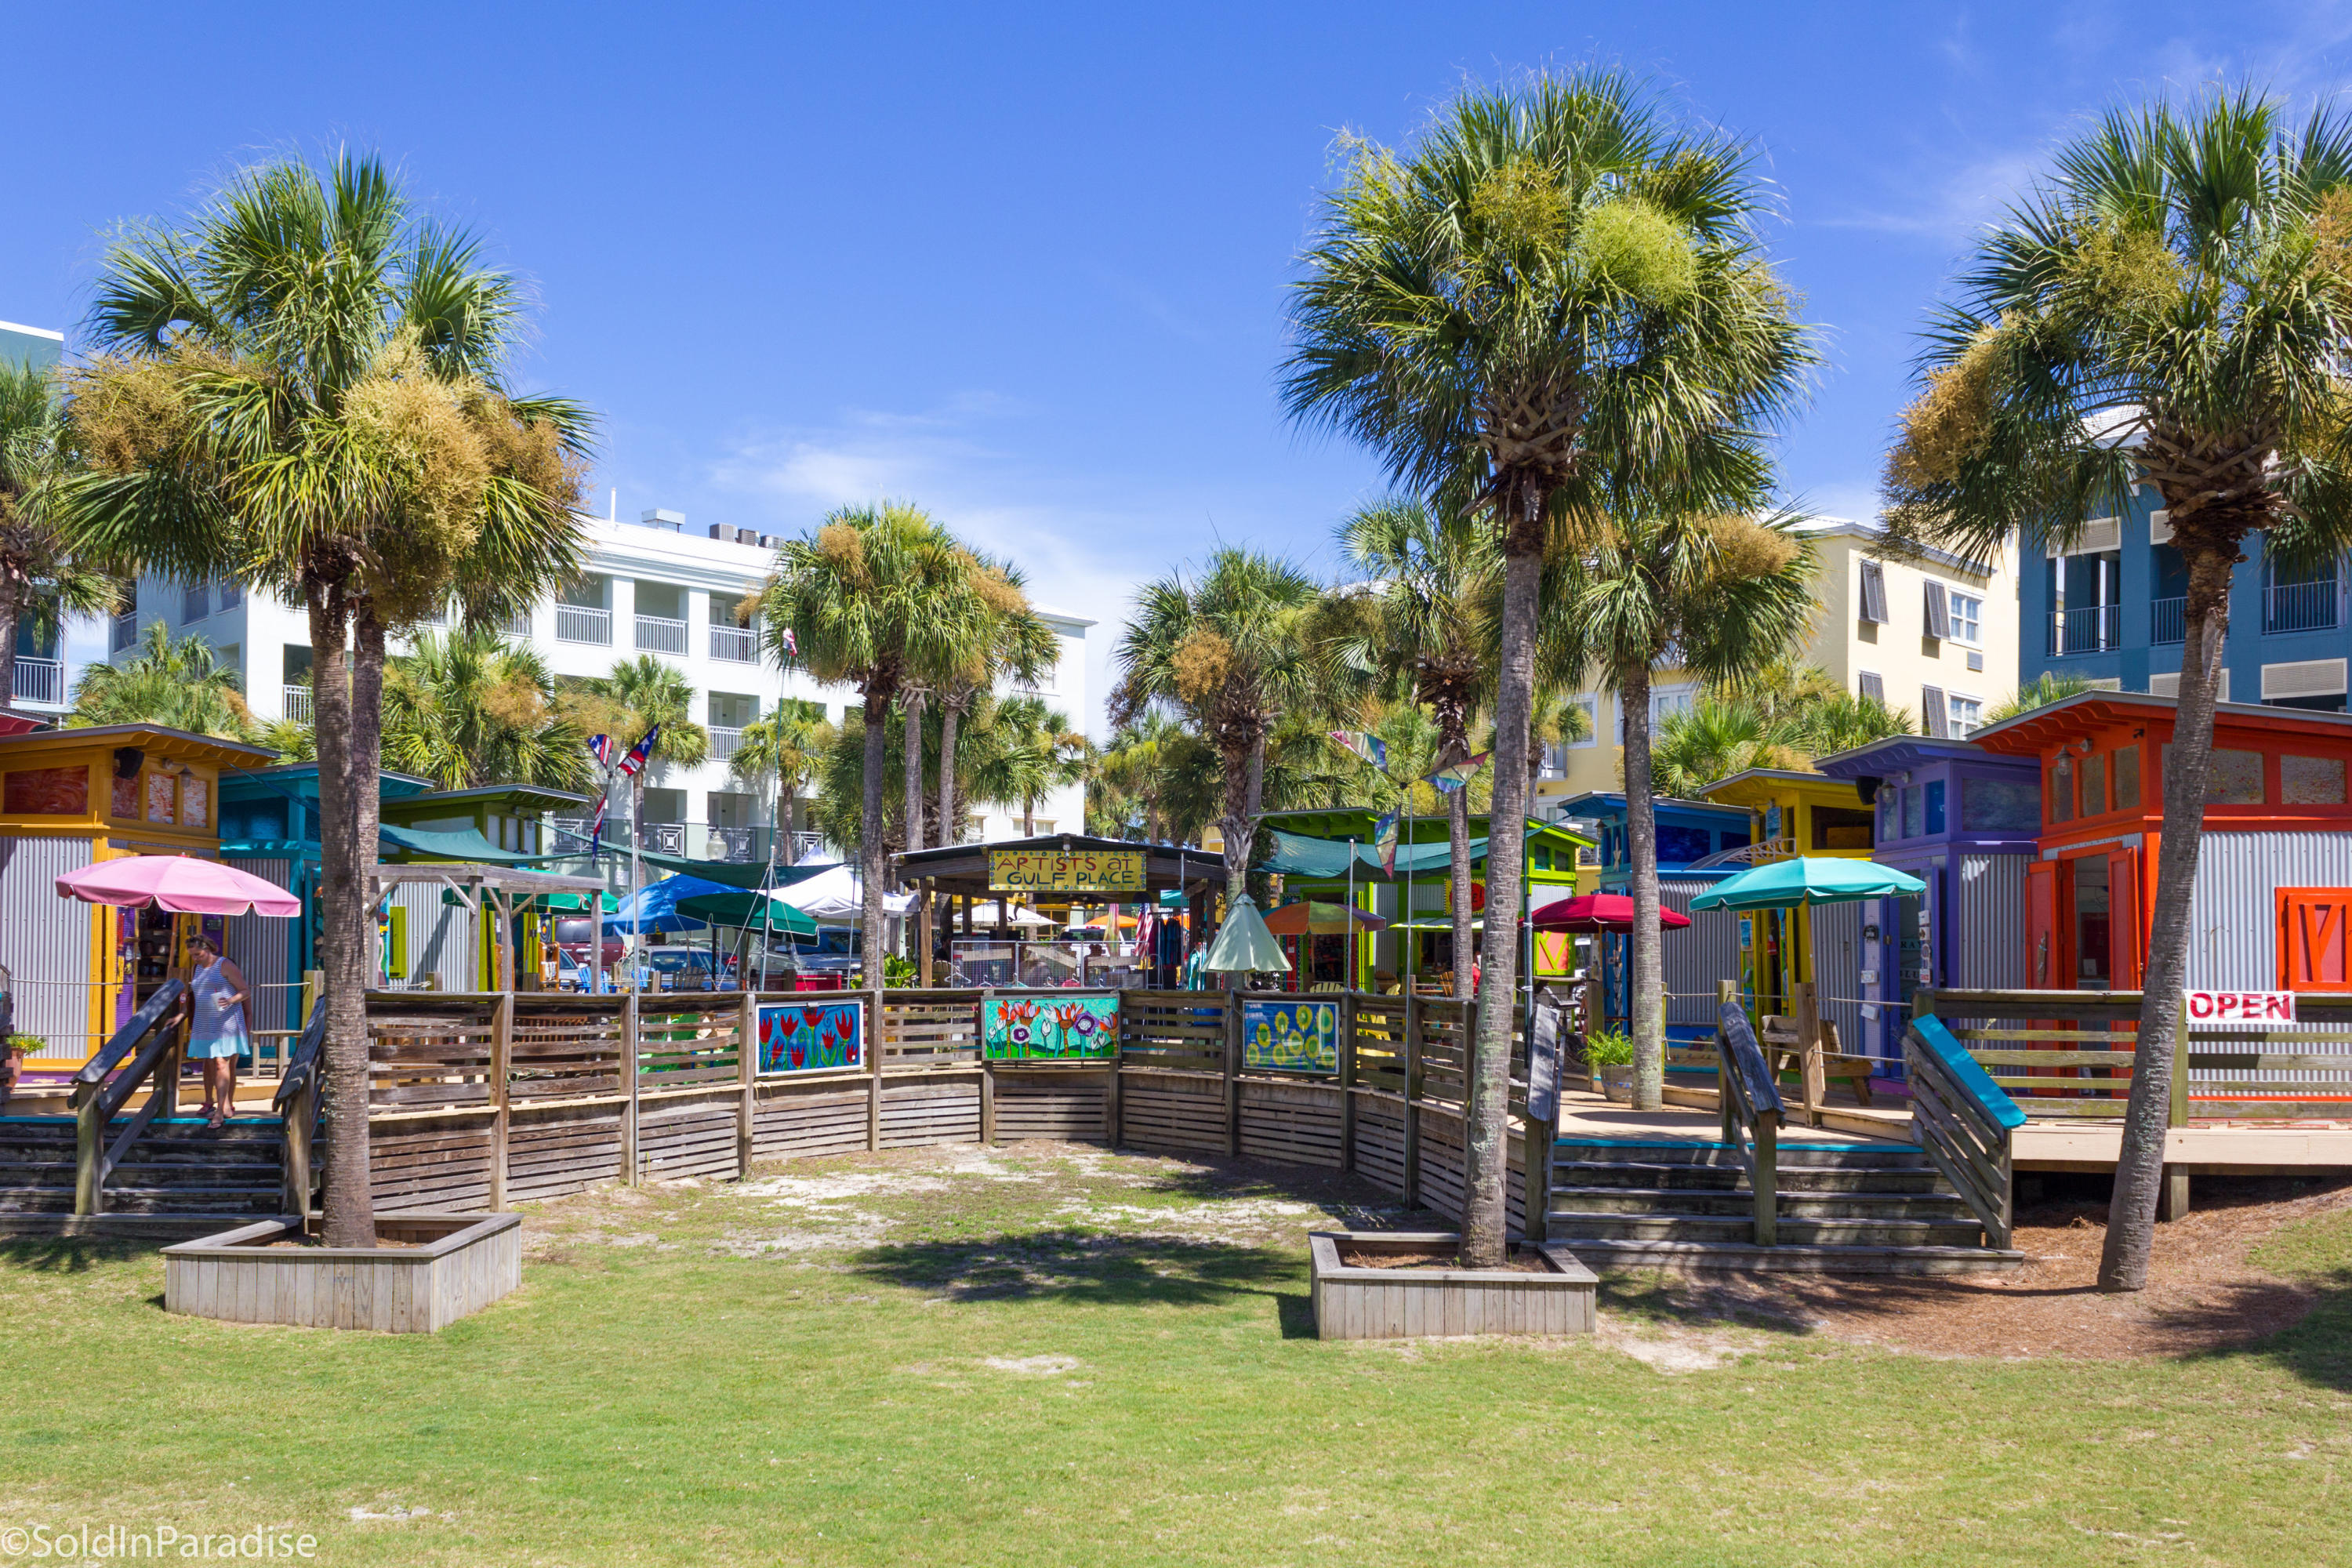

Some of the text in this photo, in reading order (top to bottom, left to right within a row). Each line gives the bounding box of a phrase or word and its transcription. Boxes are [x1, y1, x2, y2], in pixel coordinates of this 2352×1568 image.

[997, 857, 1096, 871] ARTISTS
[1007, 871, 1134, 885] GULF PLACE
[2190, 993, 2291, 1019] OPEN
